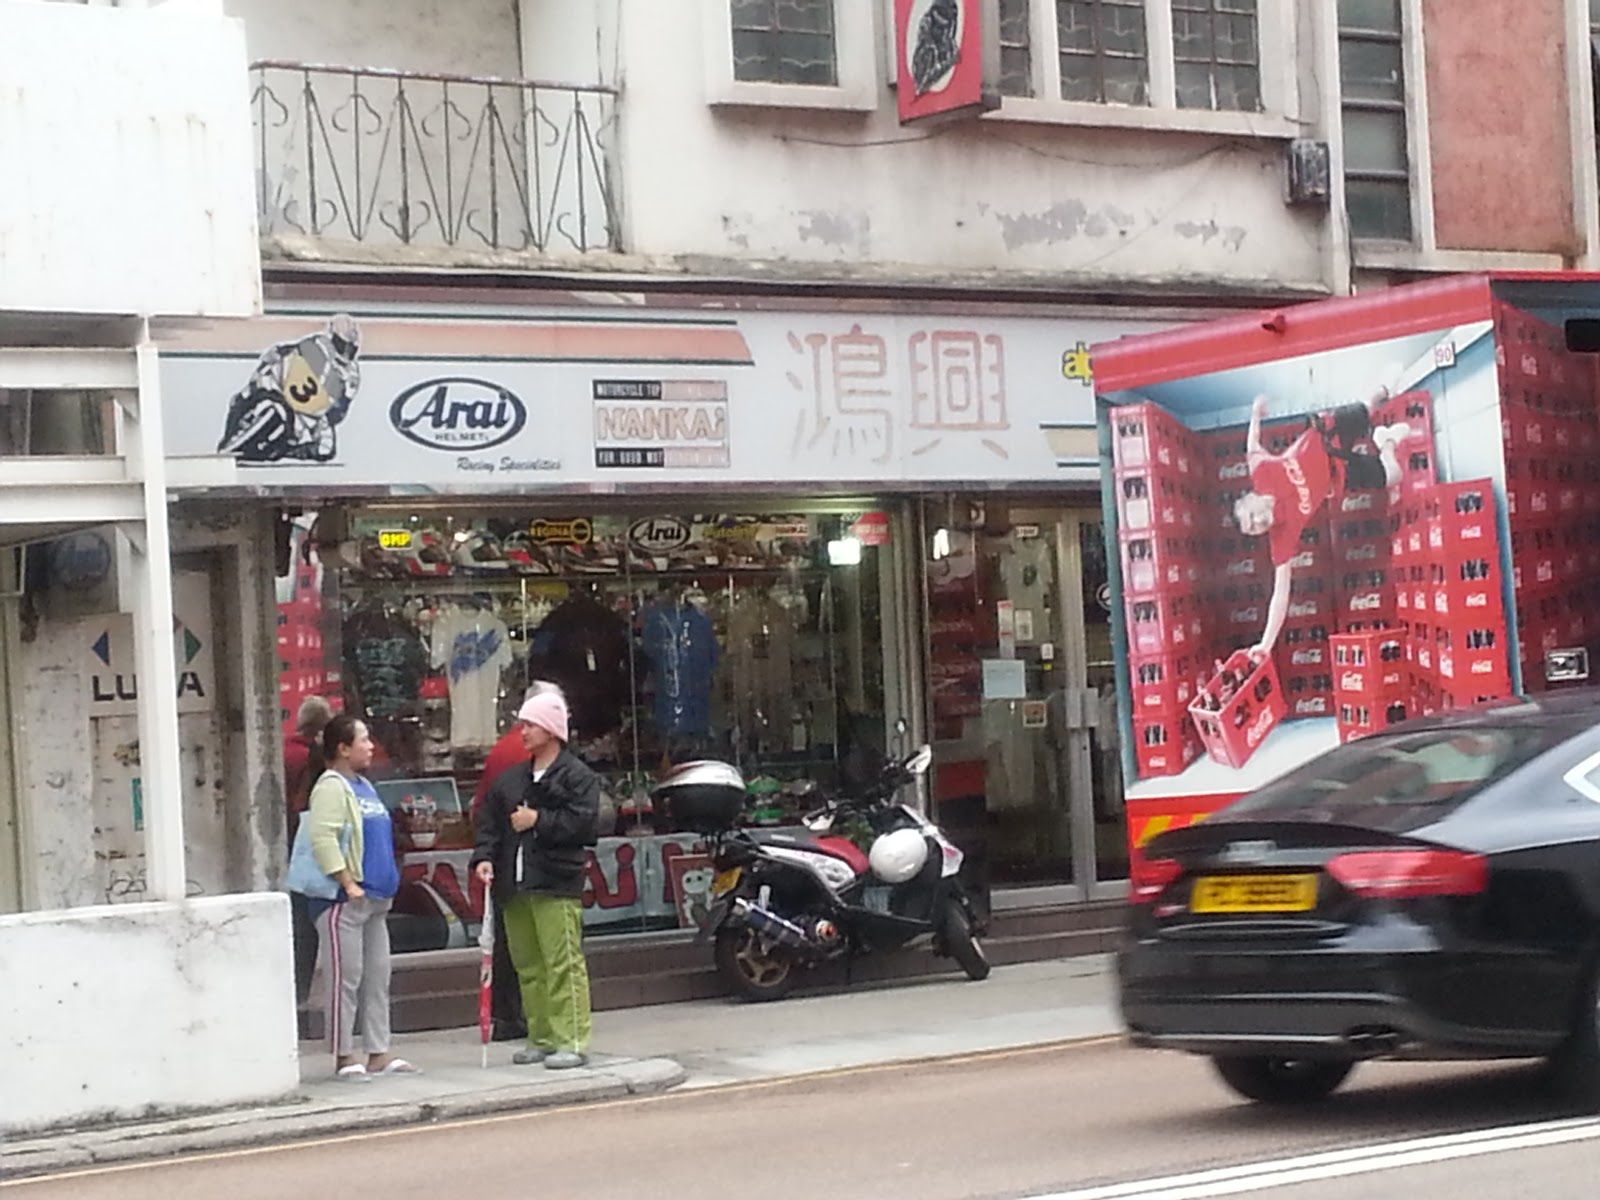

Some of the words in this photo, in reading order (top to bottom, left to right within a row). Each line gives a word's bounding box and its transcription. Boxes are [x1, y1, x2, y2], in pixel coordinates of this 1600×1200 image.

[401, 385, 511, 430] Arai
[457, 456, 495, 473] Racing
[635, 521, 682, 542] Arai
[92, 671, 205, 702] LUA
